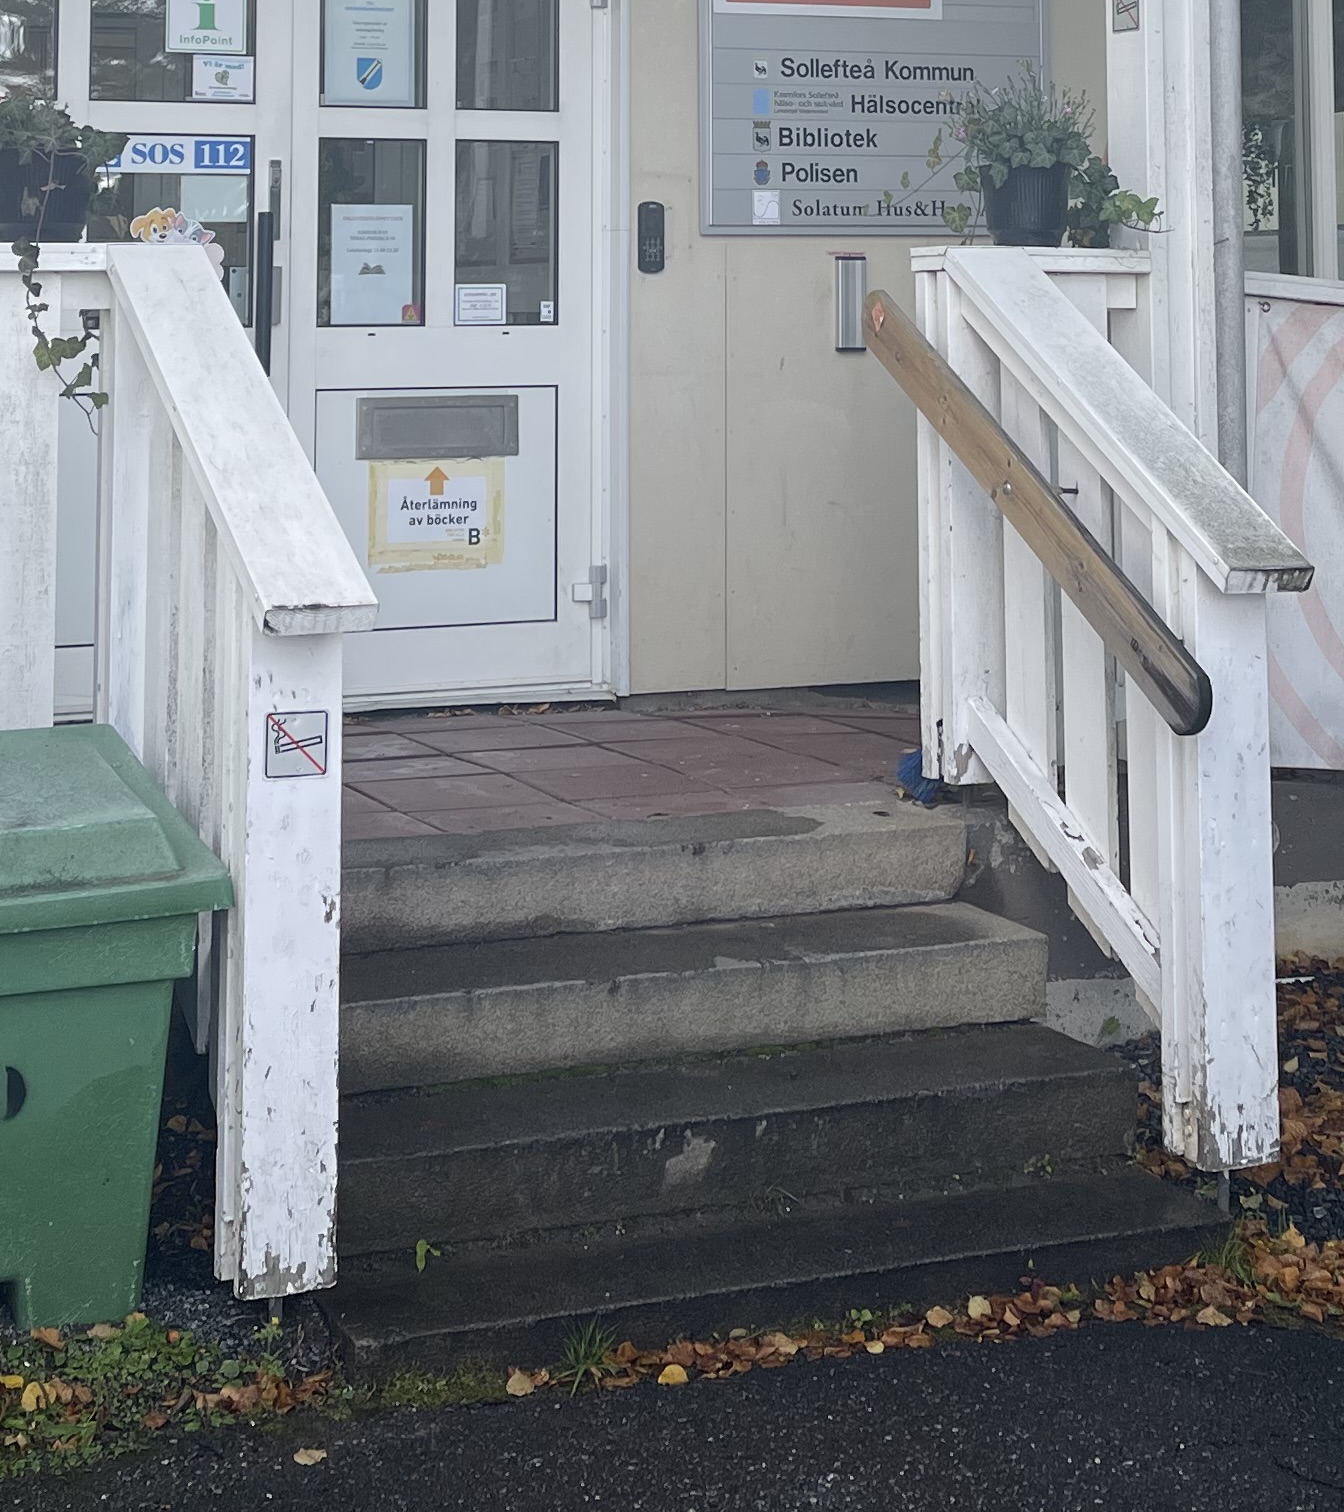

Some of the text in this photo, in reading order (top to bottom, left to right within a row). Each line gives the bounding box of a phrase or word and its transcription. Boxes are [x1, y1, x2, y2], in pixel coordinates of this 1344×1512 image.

[179, 34, 233, 46] InfoPoint
[780, 57, 975, 82] Sollefteå Kommun
[778, 126, 879, 149] Bibliotek
[131, 142, 185, 165] SOS
[199, 143, 246, 167] 112
[781, 161, 859, 184] Polisen
[400, 495, 478, 512] Återlämning
[408, 513, 470, 526] av böcker
